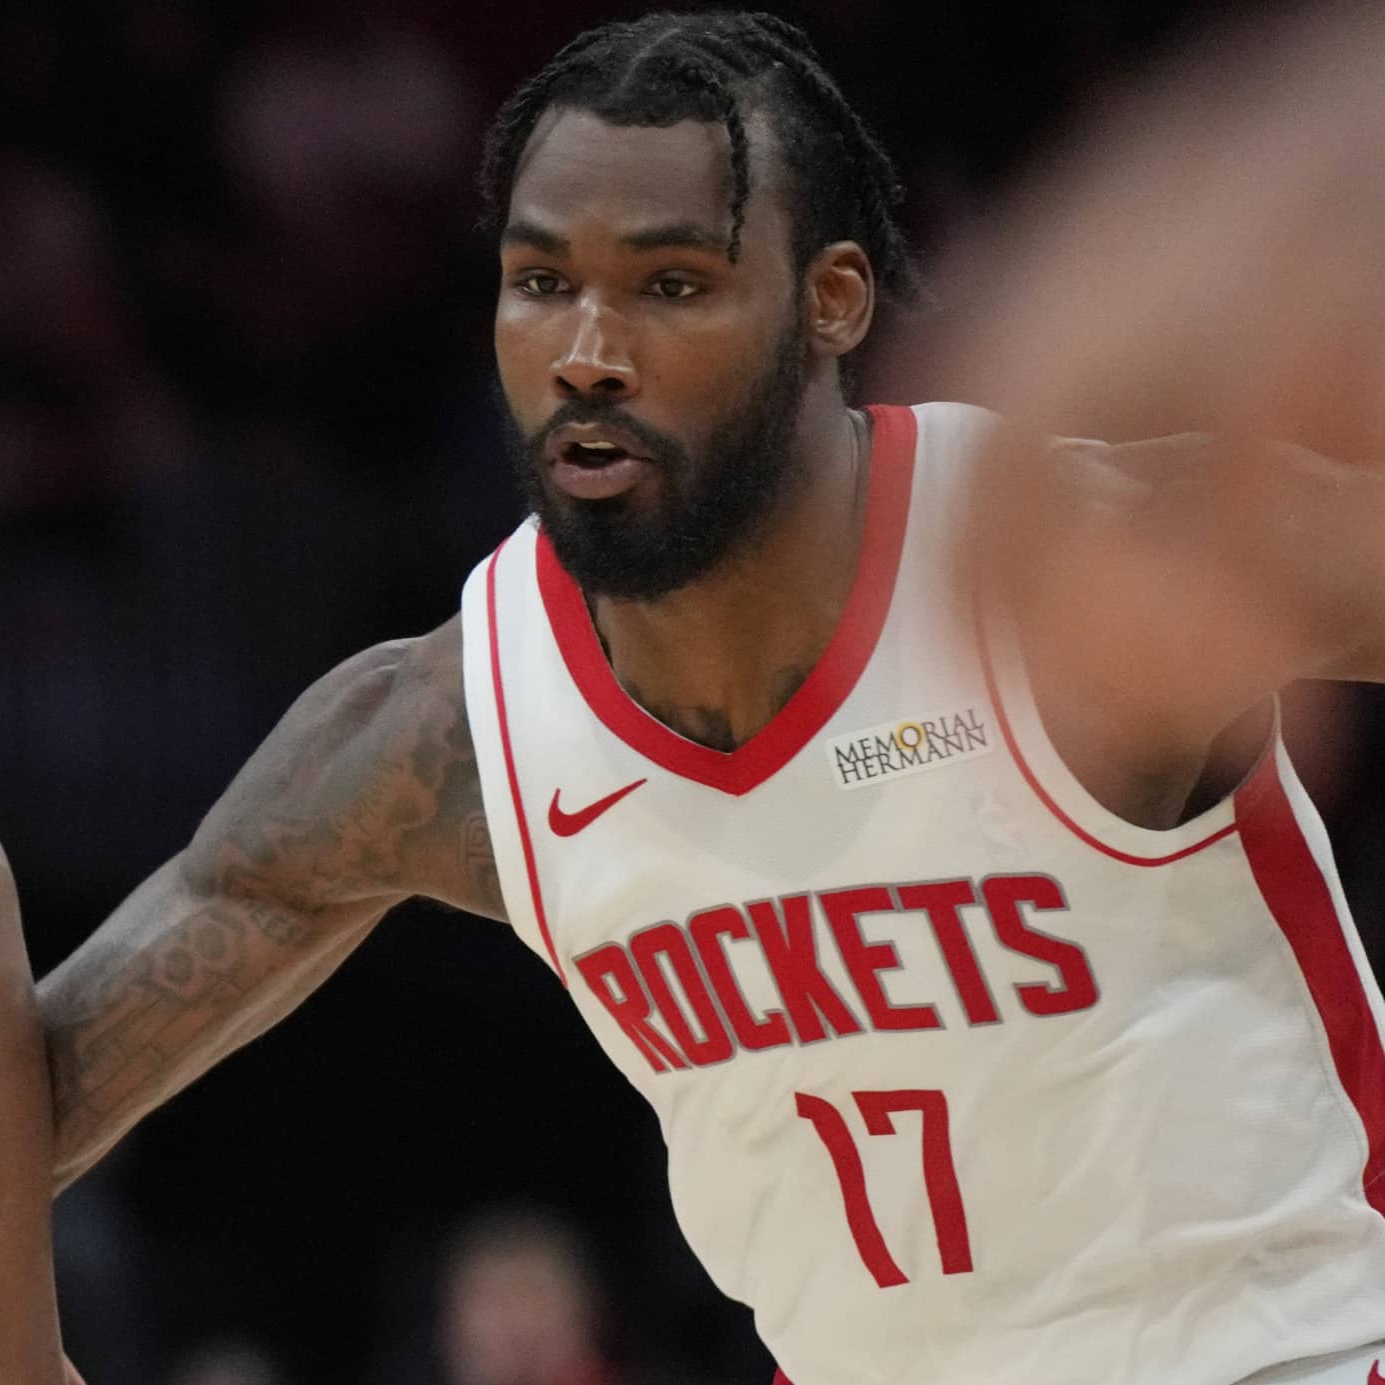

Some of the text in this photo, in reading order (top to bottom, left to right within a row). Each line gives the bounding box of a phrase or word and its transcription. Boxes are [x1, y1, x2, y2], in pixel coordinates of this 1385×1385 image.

[835, 708, 985, 767] MEMORIAL
[838, 722, 988, 785] HERMANN
[571, 872, 1100, 1075] ROCKETS
[794, 1088, 974, 1289] 17
